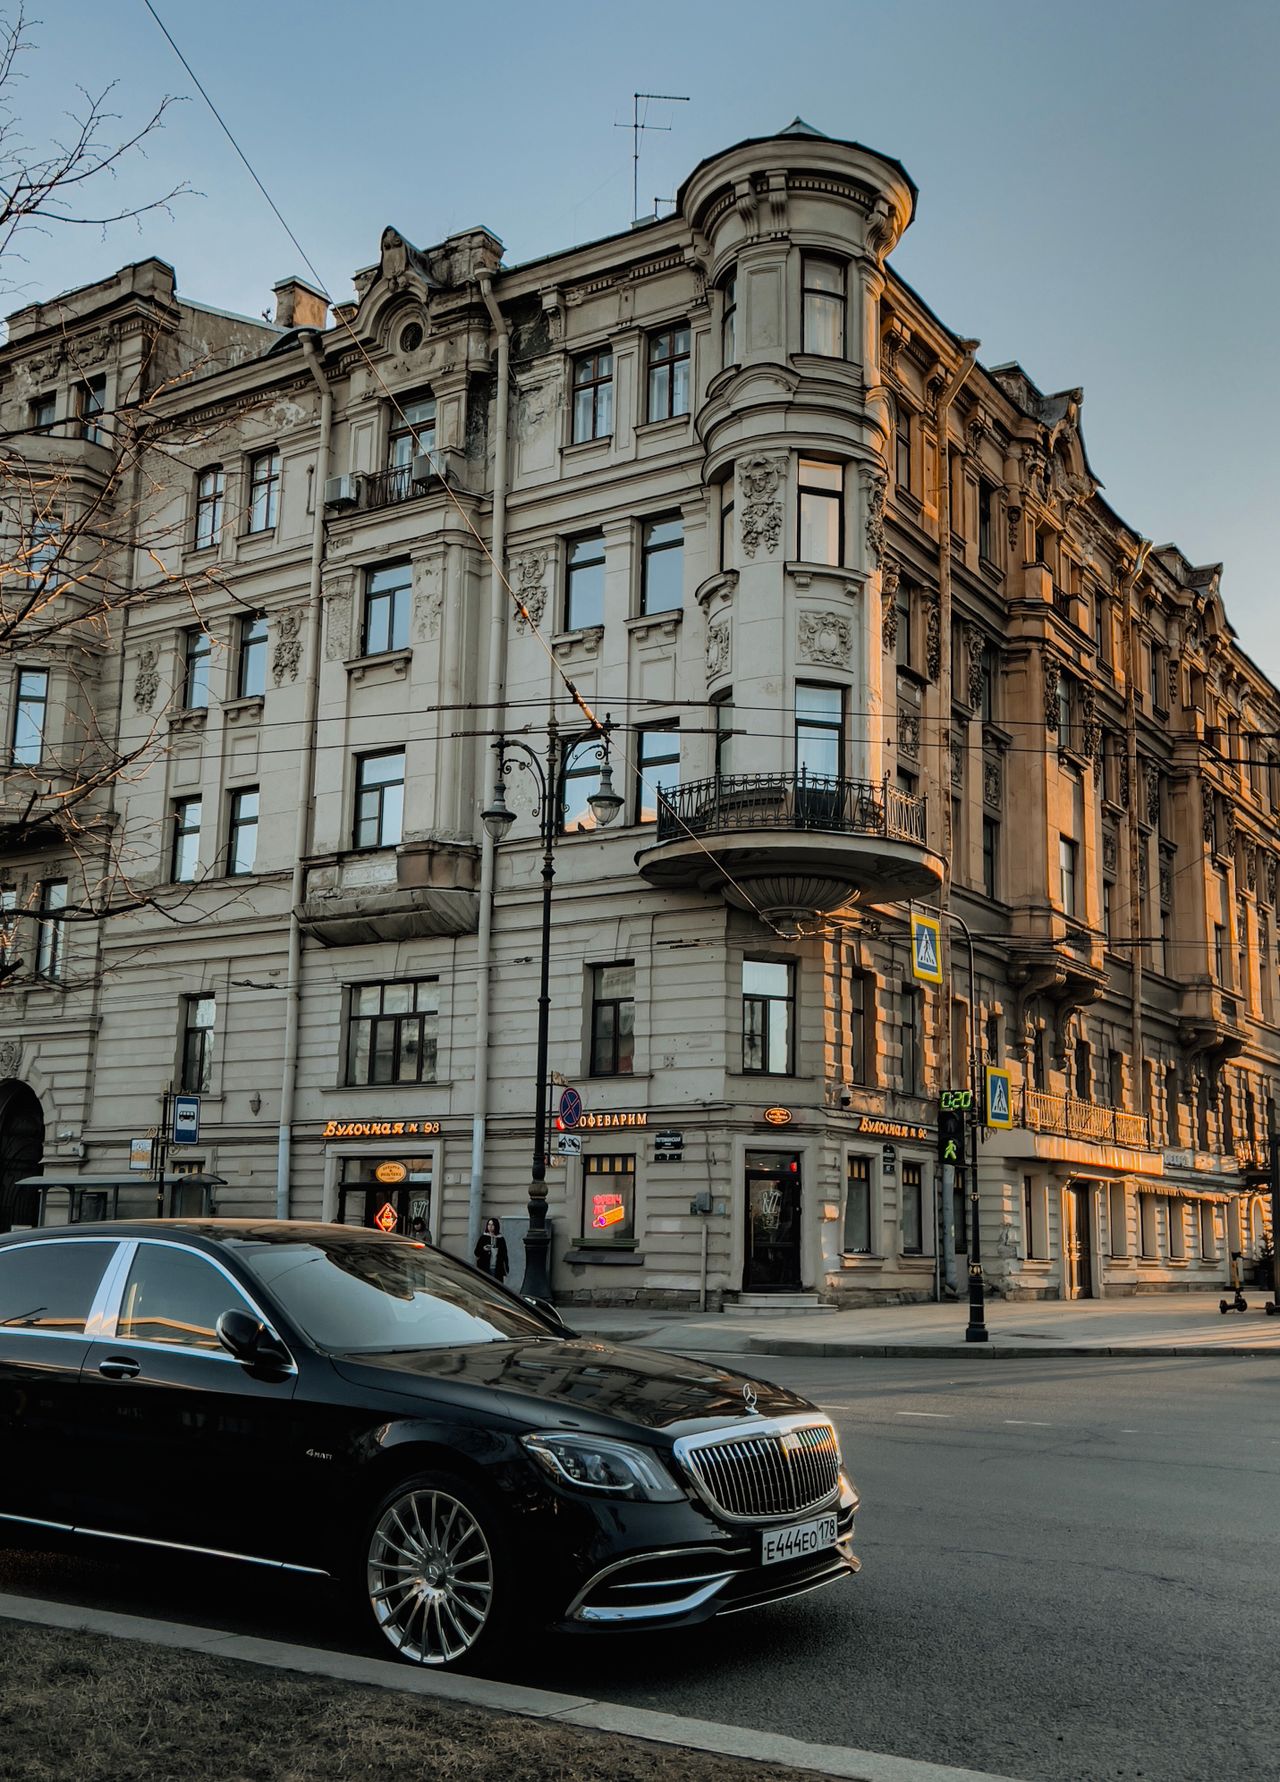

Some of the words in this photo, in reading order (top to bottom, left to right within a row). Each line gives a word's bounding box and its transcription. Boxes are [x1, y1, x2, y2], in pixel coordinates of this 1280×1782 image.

[576, 1112, 647, 1128] ОФЕВАРИМ
[323, 1121, 405, 1137] Булочная
[424, 1122, 440, 1133] 98
[818, 1519, 836, 1540] 178
